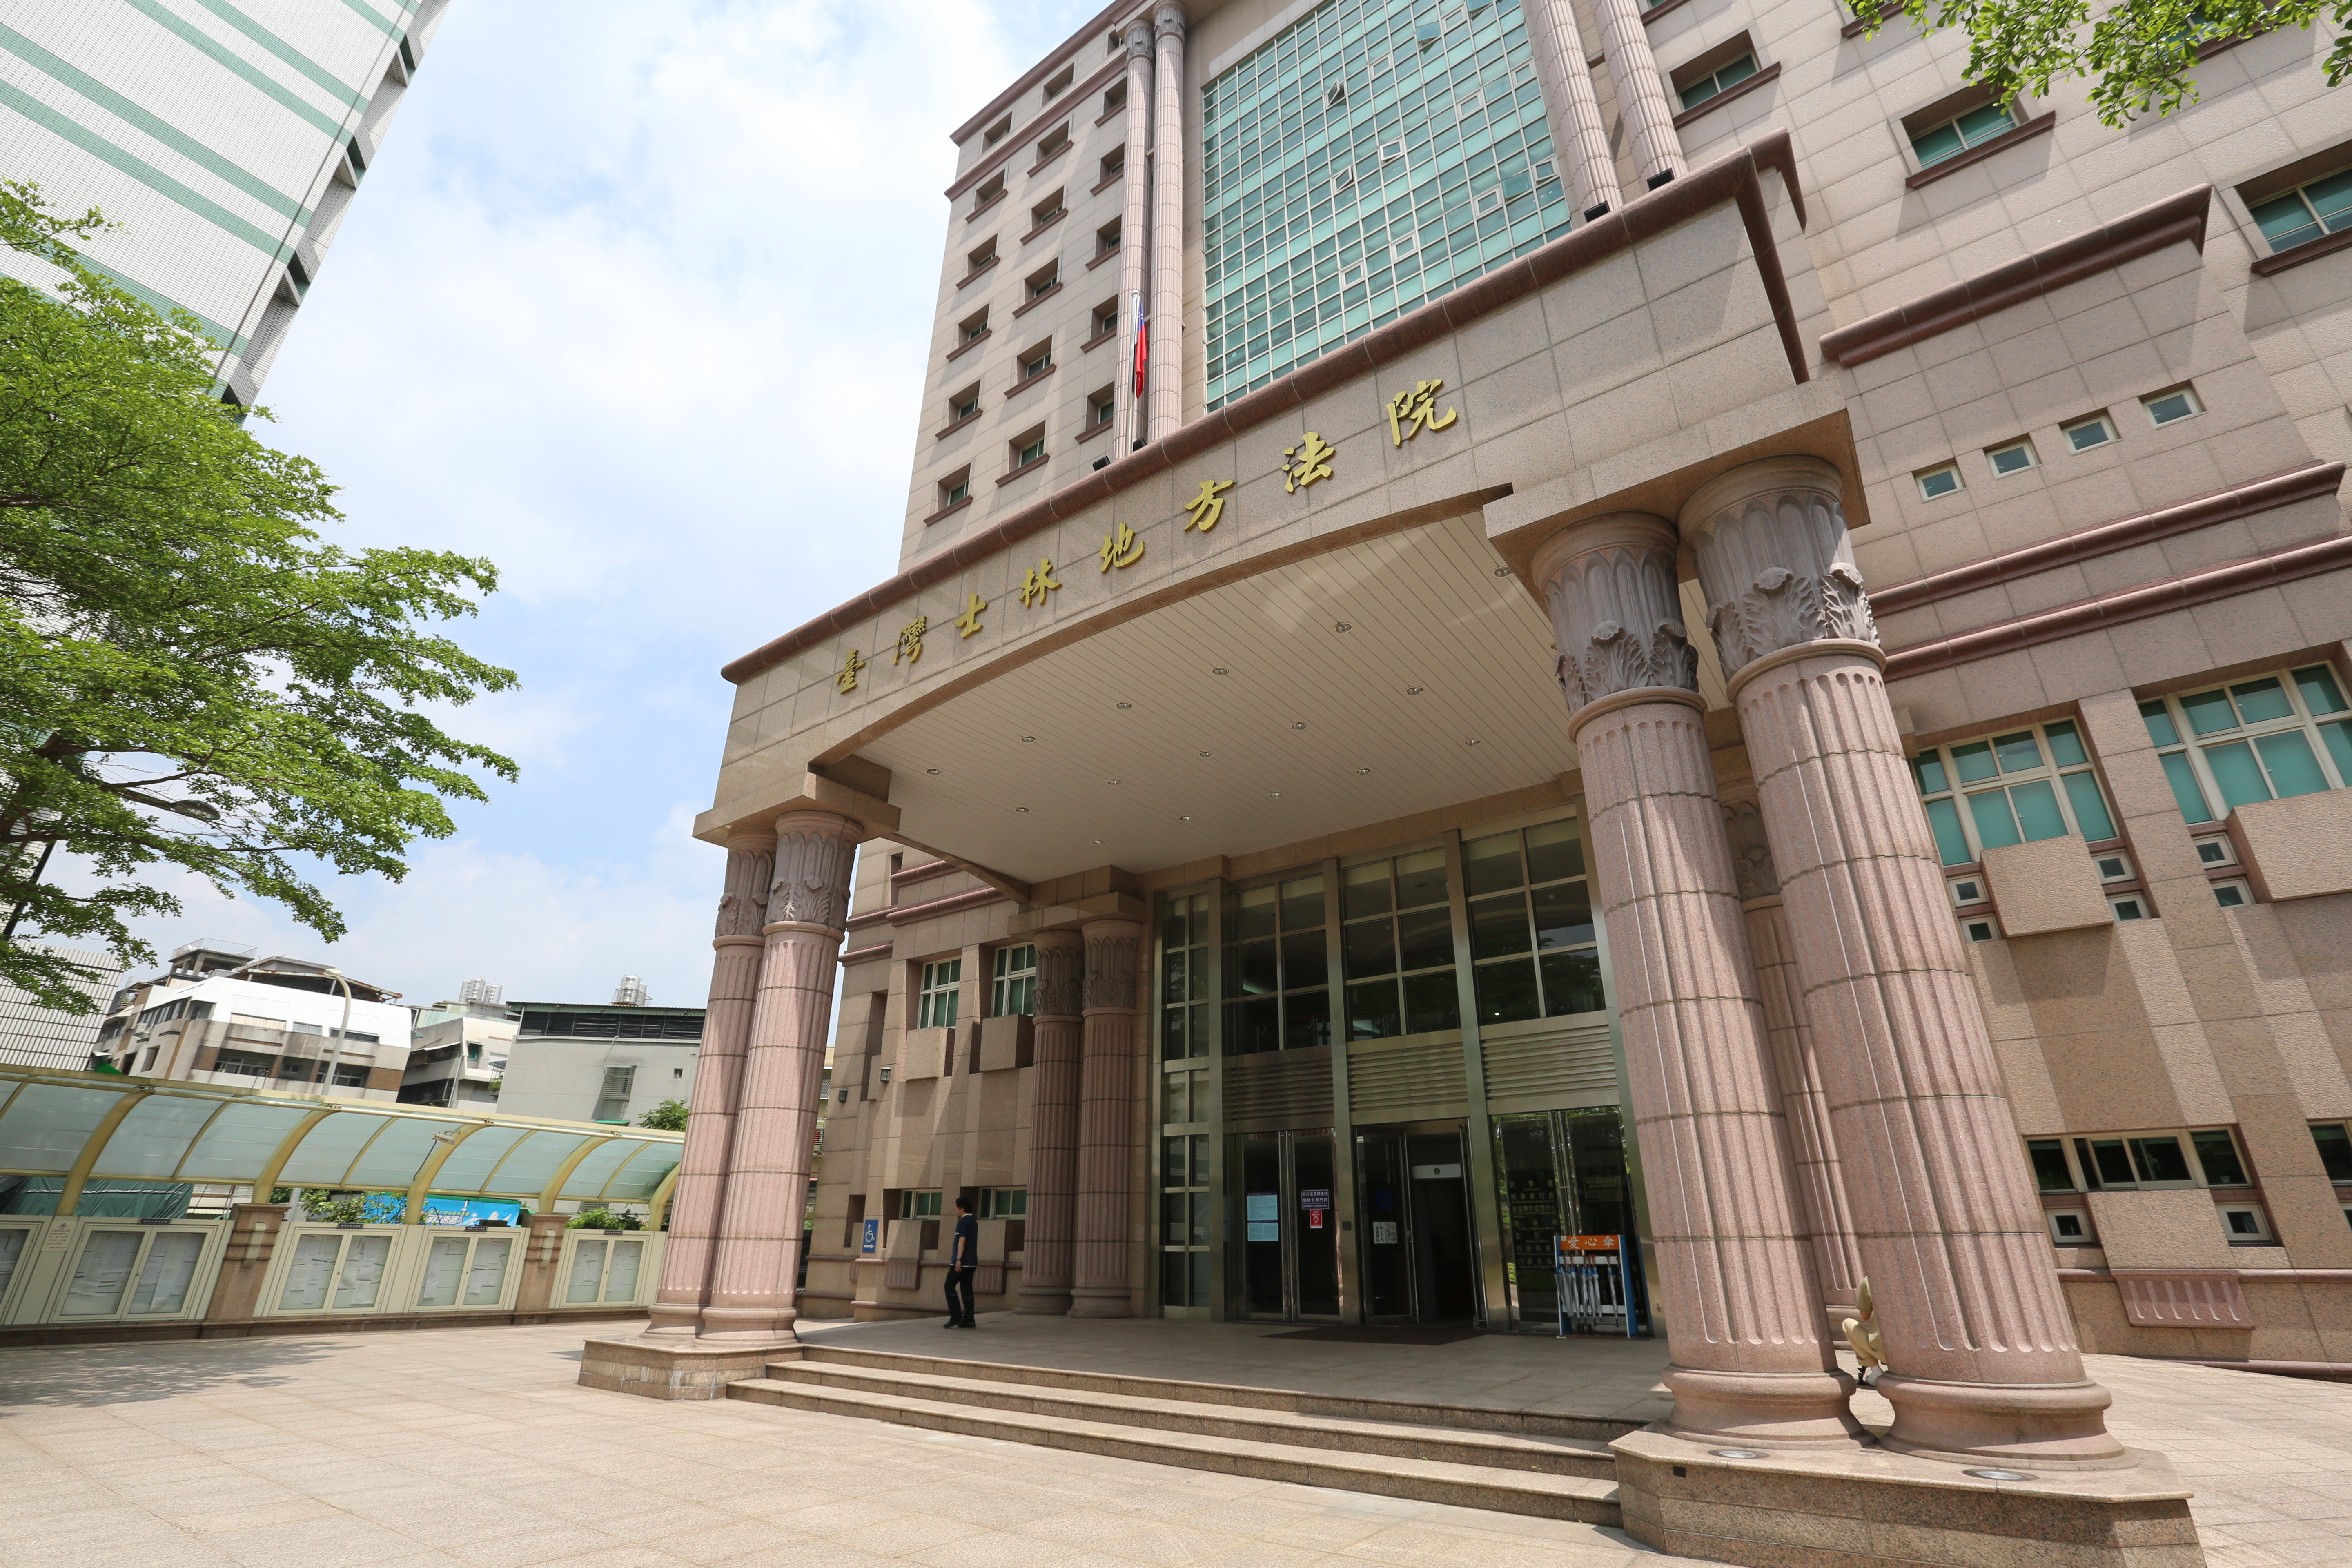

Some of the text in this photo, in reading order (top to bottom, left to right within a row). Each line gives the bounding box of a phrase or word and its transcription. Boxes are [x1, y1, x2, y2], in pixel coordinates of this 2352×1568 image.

[837, 379, 1457, 693] 臺灣士林地方法院
[1568, 1235, 1615, 1249] 愛心傘
